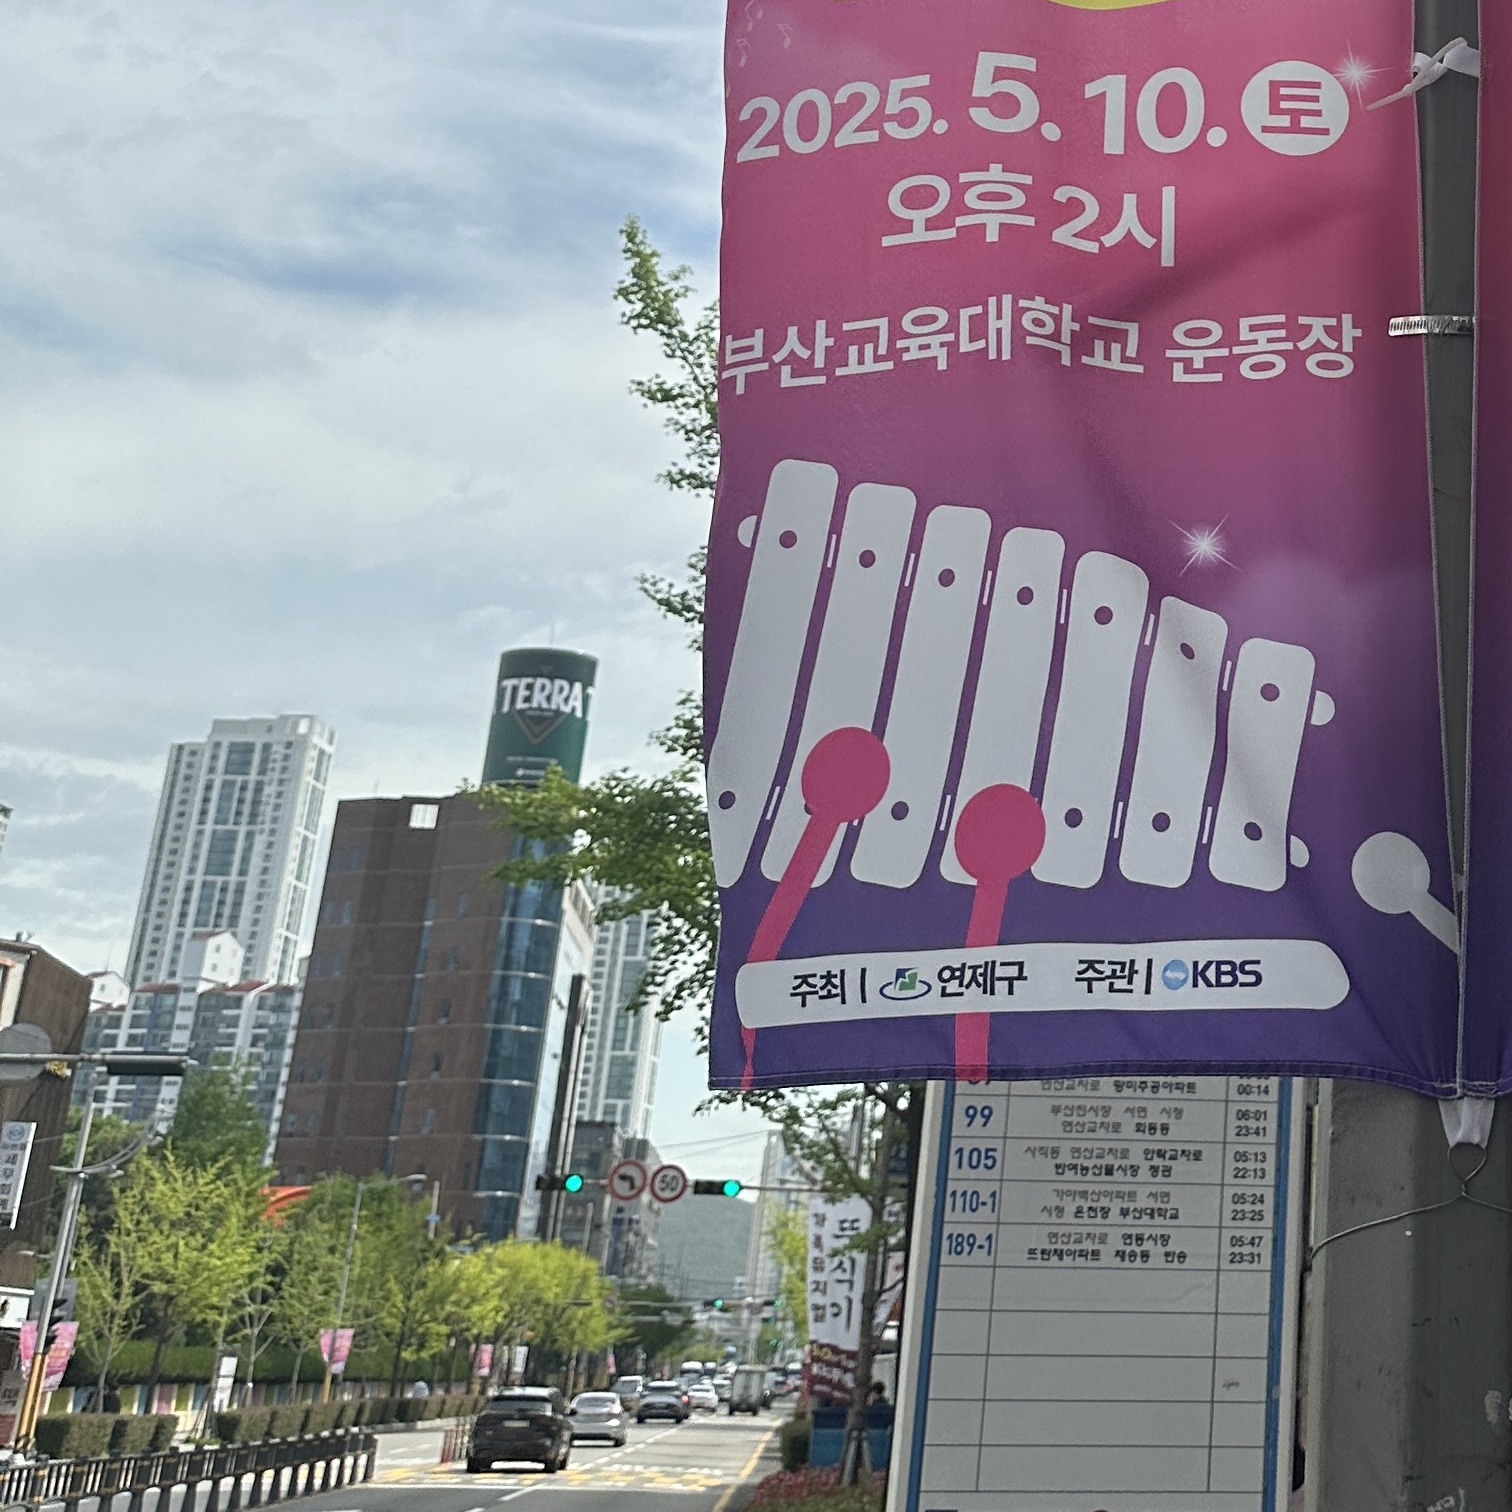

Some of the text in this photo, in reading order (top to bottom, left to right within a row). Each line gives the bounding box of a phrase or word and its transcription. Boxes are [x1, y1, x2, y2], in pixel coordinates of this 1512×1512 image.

[736, 74, 949, 164] 2025.
[967, 51, 1062, 143] 5.
[880, 163, 1177, 268] 오후 2시
[720, 293, 1362, 396] 부산교육대학교 운동장
[501, 677, 584, 719] TERRA
[789, 957, 1264, 1009] 주최 연제구 주관 KBS
[964, 1104, 994, 1129] 99
[1122, 1104, 1149, 1120] 서면
[1060, 1120, 1123, 1135] 연산교차로
[1233, 1124, 1268, 1139] 23:41
[953, 1145, 998, 1172] 105
[1023, 1144, 1205, 1164] 사직동 연산교차로 안락교차로
[1232, 1149, 1268, 1165] 05:13
[1232, 1166, 1268, 1181] 22:13
[657, 1172, 681, 1193] 50
[949, 1189, 999, 1215] 110-1
[1146, 1189, 1172, 1205] 서면
[1230, 1191, 1267, 1207] 05:24
[1040, 1204, 1181, 1221] 시청 온천장 부산대학교
[1230, 1207, 1266, 1223] 23:25
[946, 1232, 995, 1258] 189-1
[1047, 1231, 1109, 1246] 연산교차로
[1229, 1234, 1265, 1250] 05:47
[1228, 1250, 1263, 1267] 23:31
